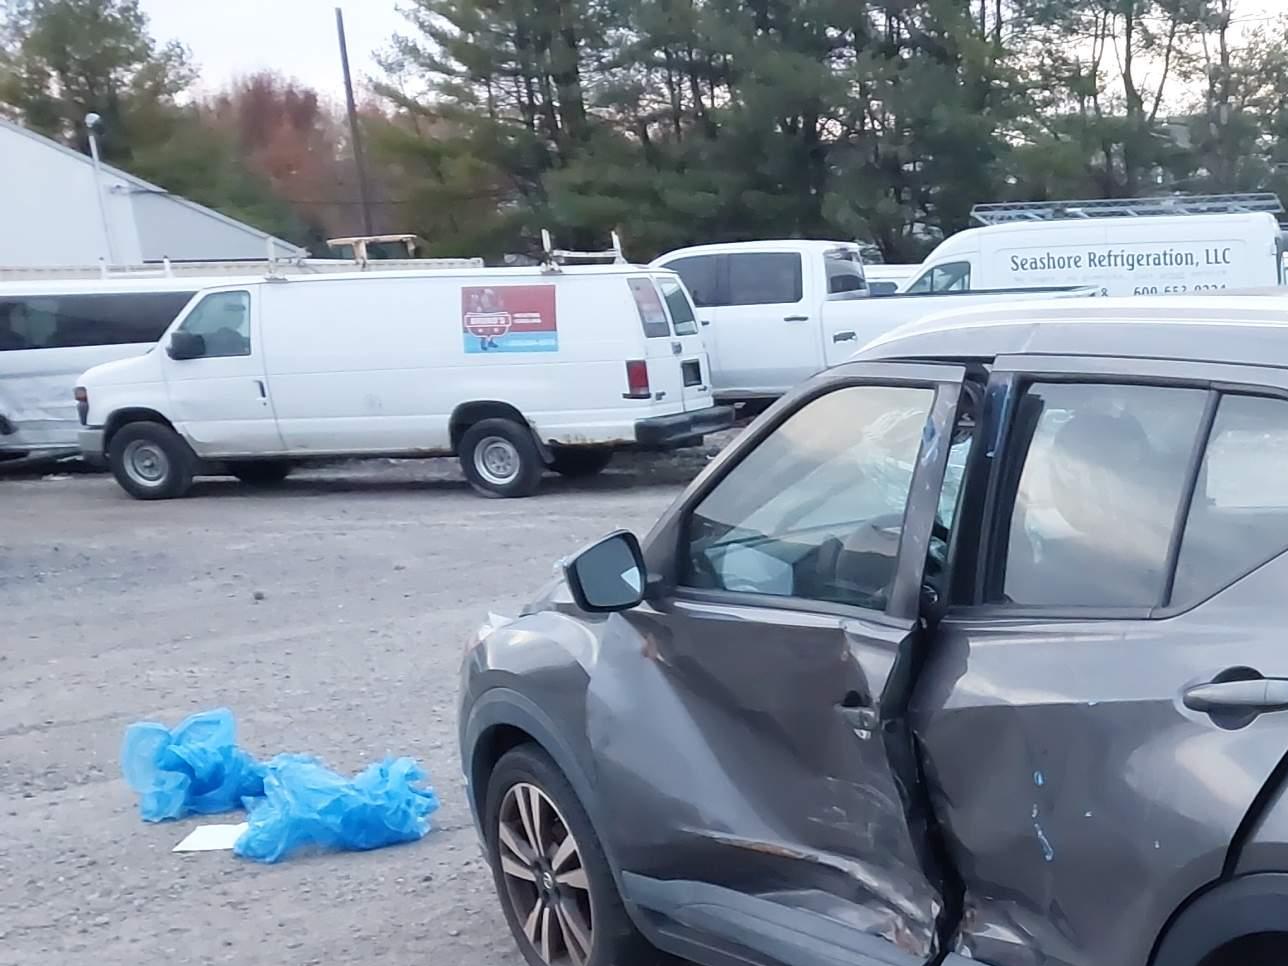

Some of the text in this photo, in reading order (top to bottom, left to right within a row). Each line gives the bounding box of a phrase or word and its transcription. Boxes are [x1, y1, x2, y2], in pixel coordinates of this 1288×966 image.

[1010, 247, 1231, 272] Seashore Refrigeration, LLC
